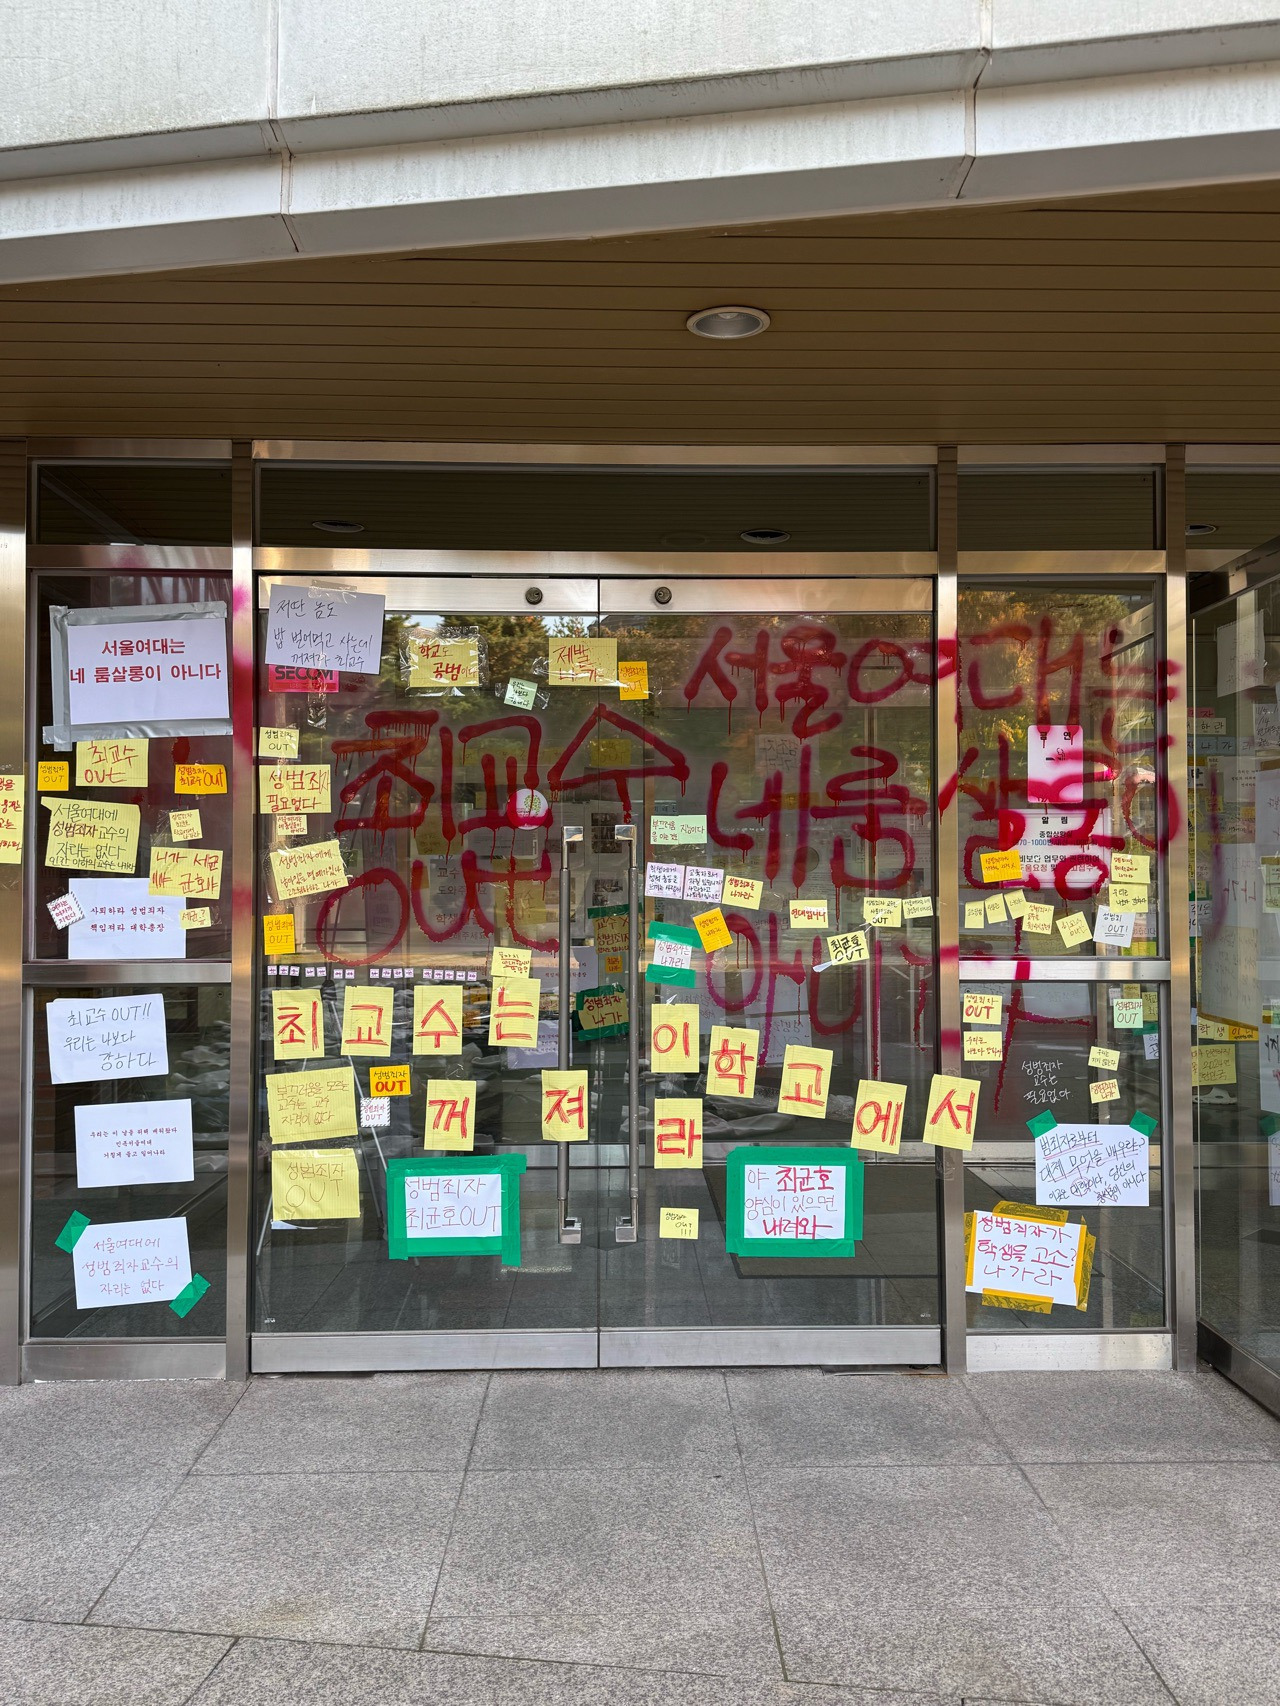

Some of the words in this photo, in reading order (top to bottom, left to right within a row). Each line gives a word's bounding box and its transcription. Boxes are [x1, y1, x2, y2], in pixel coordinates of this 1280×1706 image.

[101, 638, 186, 656] 서울여대는
[274, 627, 286, 650] 밥
[340, 631, 373, 655] 사는데
[419, 644, 453, 659] 학교도
[552, 644, 597, 669] 제발
[70, 667, 85, 683] 네
[94, 665, 161, 683] 룸살롱이
[170, 663, 221, 680] 아니다
[432, 661, 478, 681] 공범이다
[87, 740, 139, 768] 최교수
[268, 742, 289, 751] OUT
[43, 775, 63, 783] OUT
[331, 703, 691, 838] 최교수
[268, 769, 331, 794] 성범죄자
[53, 803, 119, 822] 서울여대에
[52, 821, 98, 839] 성범죄자
[98, 825, 130, 842] 교수의
[56, 841, 89, 860] 자리는
[95, 843, 126, 861] 없다
[156, 851, 188, 863] 니가
[193, 853, 219, 871] 세균
[90, 906, 126, 916] 사퇴하라
[130, 905, 166, 916] 성범죄자
[90, 923, 126, 933] 책임져라
[130, 923, 166, 933] 대학총장
[269, 934, 292, 944] OUT
[67, 1008, 107, 1027] 최교수
[591, 1011, 623, 1026] 나가
[964, 1005, 994, 1020] OUT
[1116, 1012, 1139, 1025] OUT
[63, 1035, 97, 1053] 우리는
[101, 1029, 137, 1047] 나보다
[276, 1081, 323, 1099] 부끄러움을
[375, 1079, 406, 1093] OUT
[281, 1112, 311, 1127] 자격이
[313, 1110, 335, 1127] 없다
[365, 1113, 383, 1122] OUT
[89, 1130, 109, 1138] 우리는
[286, 1160, 345, 1181] 성범죄자
[746, 1168, 770, 1190] 야
[775, 1164, 835, 1193] 최균호
[285, 1177, 344, 1208] OUT
[404, 1175, 487, 1202] 성범죄자
[745, 1194, 786, 1221] 양심이
[790, 1194, 838, 1213] 있으면
[762, 1214, 834, 1240] 내려와
[93, 1237, 161, 1254] 서울여대에
[977, 1239, 1028, 1263] 학생을
[983, 1264, 1063, 1287] 나가라
[99, 1282, 131, 1297] 자리는
[140, 1278, 165, 1295] 없다
